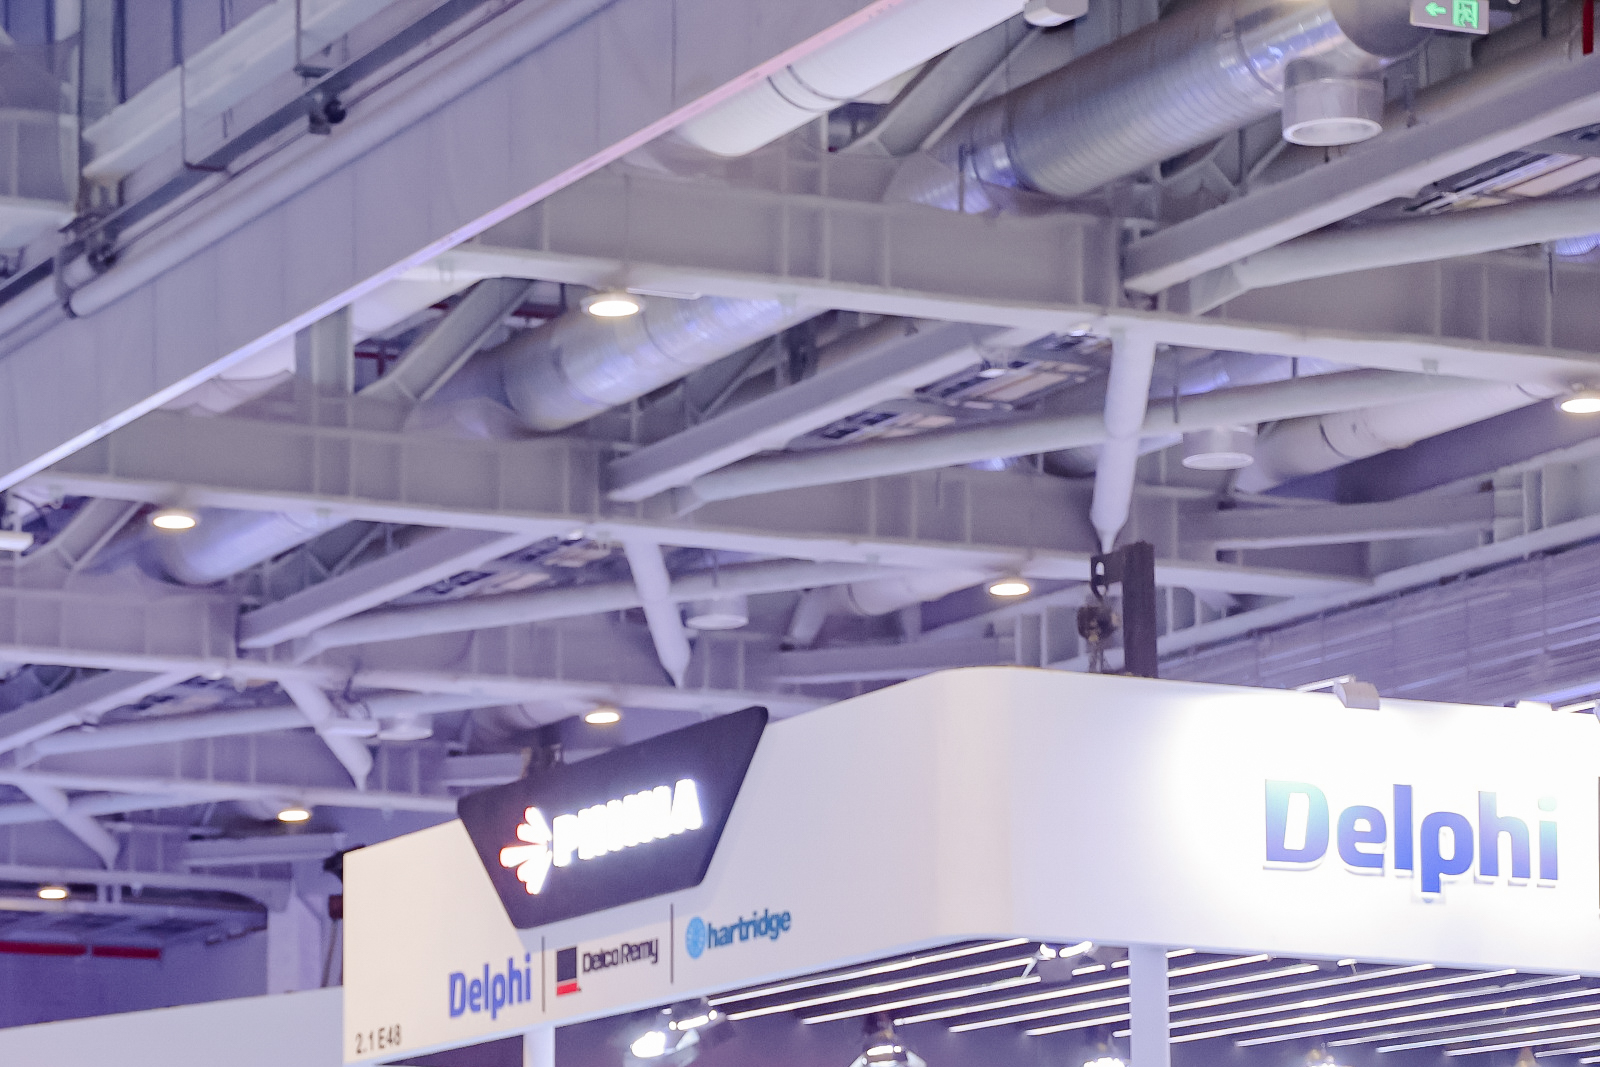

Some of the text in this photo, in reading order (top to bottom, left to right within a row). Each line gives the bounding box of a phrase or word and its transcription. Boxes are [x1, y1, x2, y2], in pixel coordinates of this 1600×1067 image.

[1264, 779, 1558, 893] Delphi
[448, 952, 532, 1020] Delphi
[621, 939, 658, 965] Remy
[708, 908, 791, 949] hartridge
